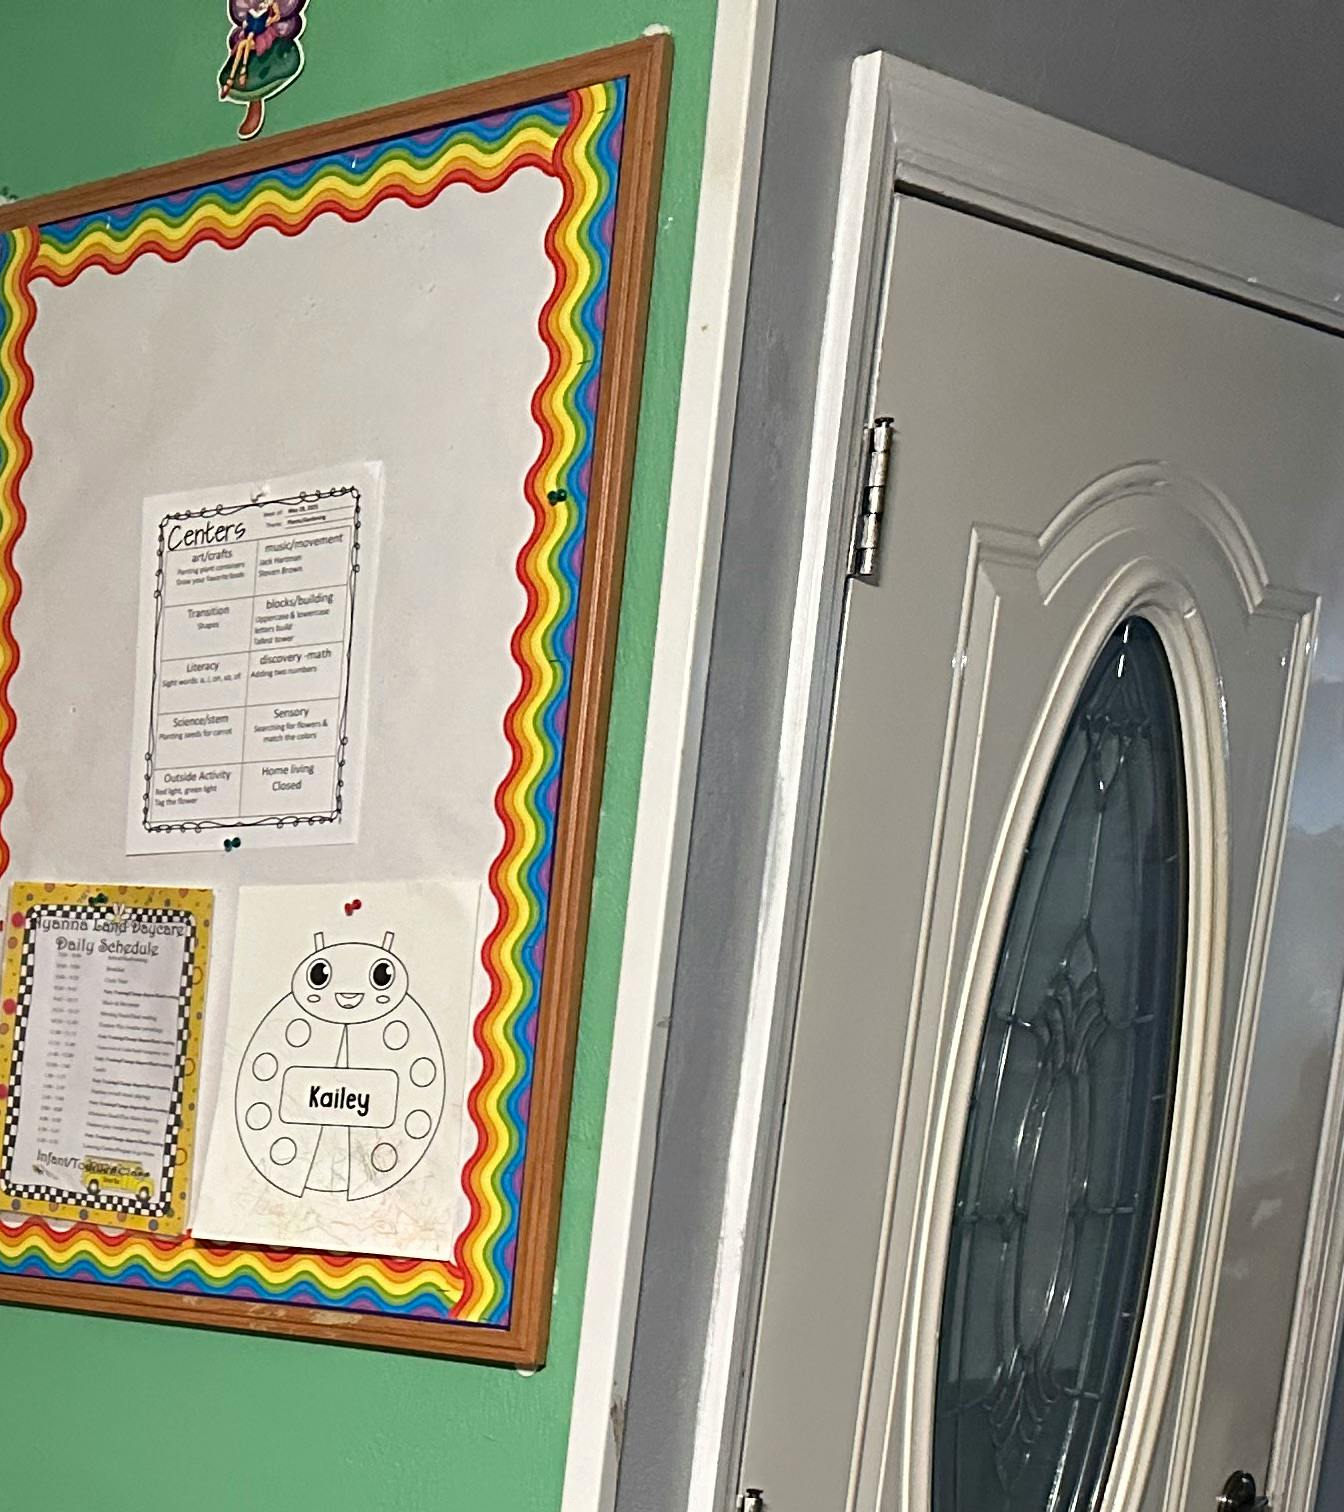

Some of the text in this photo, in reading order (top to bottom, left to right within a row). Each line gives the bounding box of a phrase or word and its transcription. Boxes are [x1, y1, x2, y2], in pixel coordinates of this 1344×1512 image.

[167, 521, 247, 551] Centers
[265, 534, 343, 552] music/movement
[192, 549, 233, 563] art/crafts
[266, 594, 334, 609] blocks/building
[188, 607, 230, 619] Transition
[260, 653, 302, 665] discovery
[186, 662, 220, 673] Literacy
[173, 713, 229, 727] Science/stem
[273, 708, 309, 719] Sensory
[164, 770, 232, 783] Outside Activity
[262, 764, 314, 776] Home living
[272, 779, 302, 791] Closed
[131, 920, 184, 938] Daycare
[55, 936, 159, 956] Daily Schedule
[308, 1085, 370, 1116] Kailey
